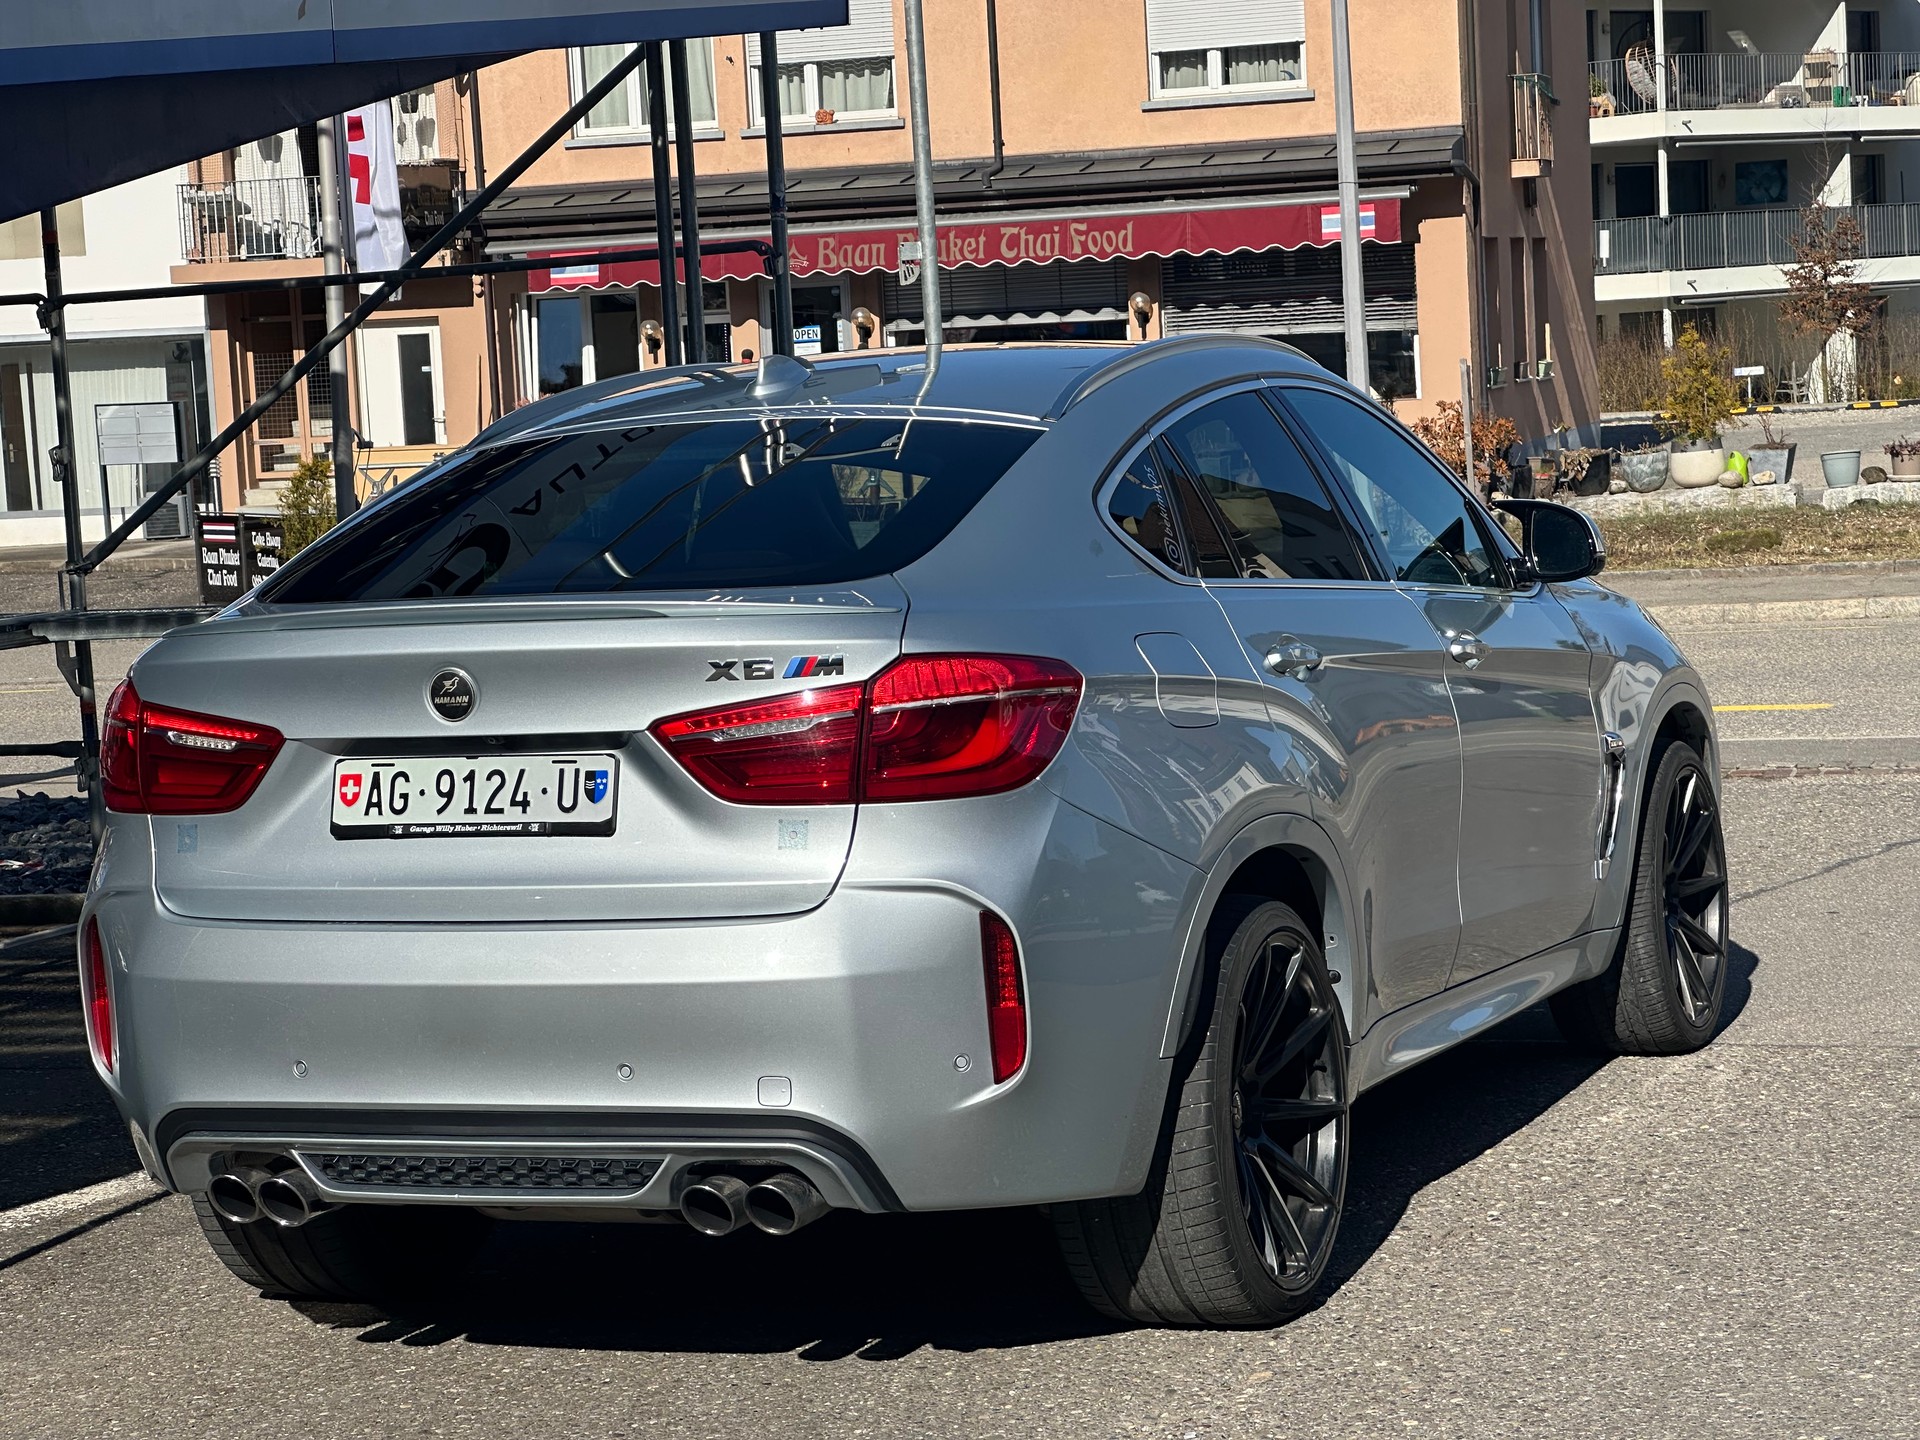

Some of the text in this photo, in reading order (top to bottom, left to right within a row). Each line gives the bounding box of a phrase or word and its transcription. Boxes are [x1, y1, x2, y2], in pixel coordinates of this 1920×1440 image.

[817, 221, 1134, 268] Baan uket Thai Food
[794, 329, 818, 340] OPEN
[251, 531, 281, 549] Take Away
[202, 547, 240, 565] Baan Phuket
[257, 553, 280, 571] Catering
[207, 569, 238, 586] Thai Food
[705, 658, 774, 682] X6
[434, 695, 469, 704] HAMANN
[409, 825, 435, 833] Garage
[435, 825, 454, 833] Willy
